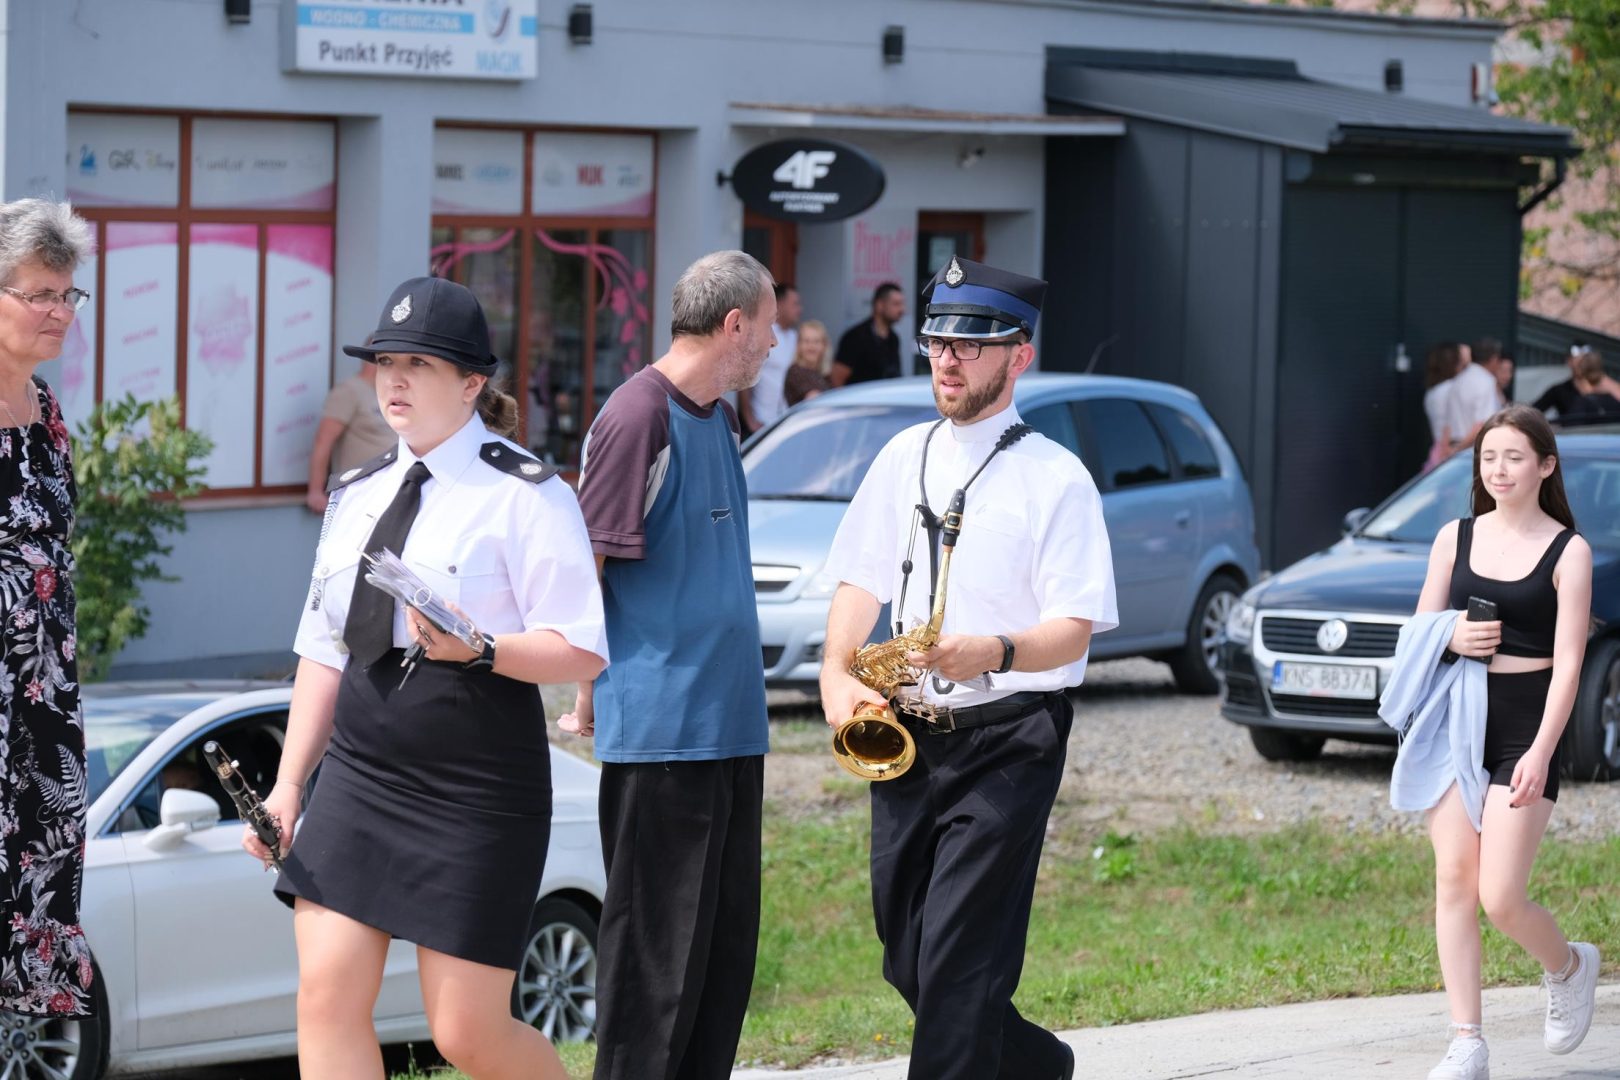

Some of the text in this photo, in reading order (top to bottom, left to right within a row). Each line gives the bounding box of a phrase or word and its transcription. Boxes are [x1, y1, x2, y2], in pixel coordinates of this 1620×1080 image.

[319, 41, 455, 71] Punkt Przyjęć
[773, 150, 837, 190] 4F
